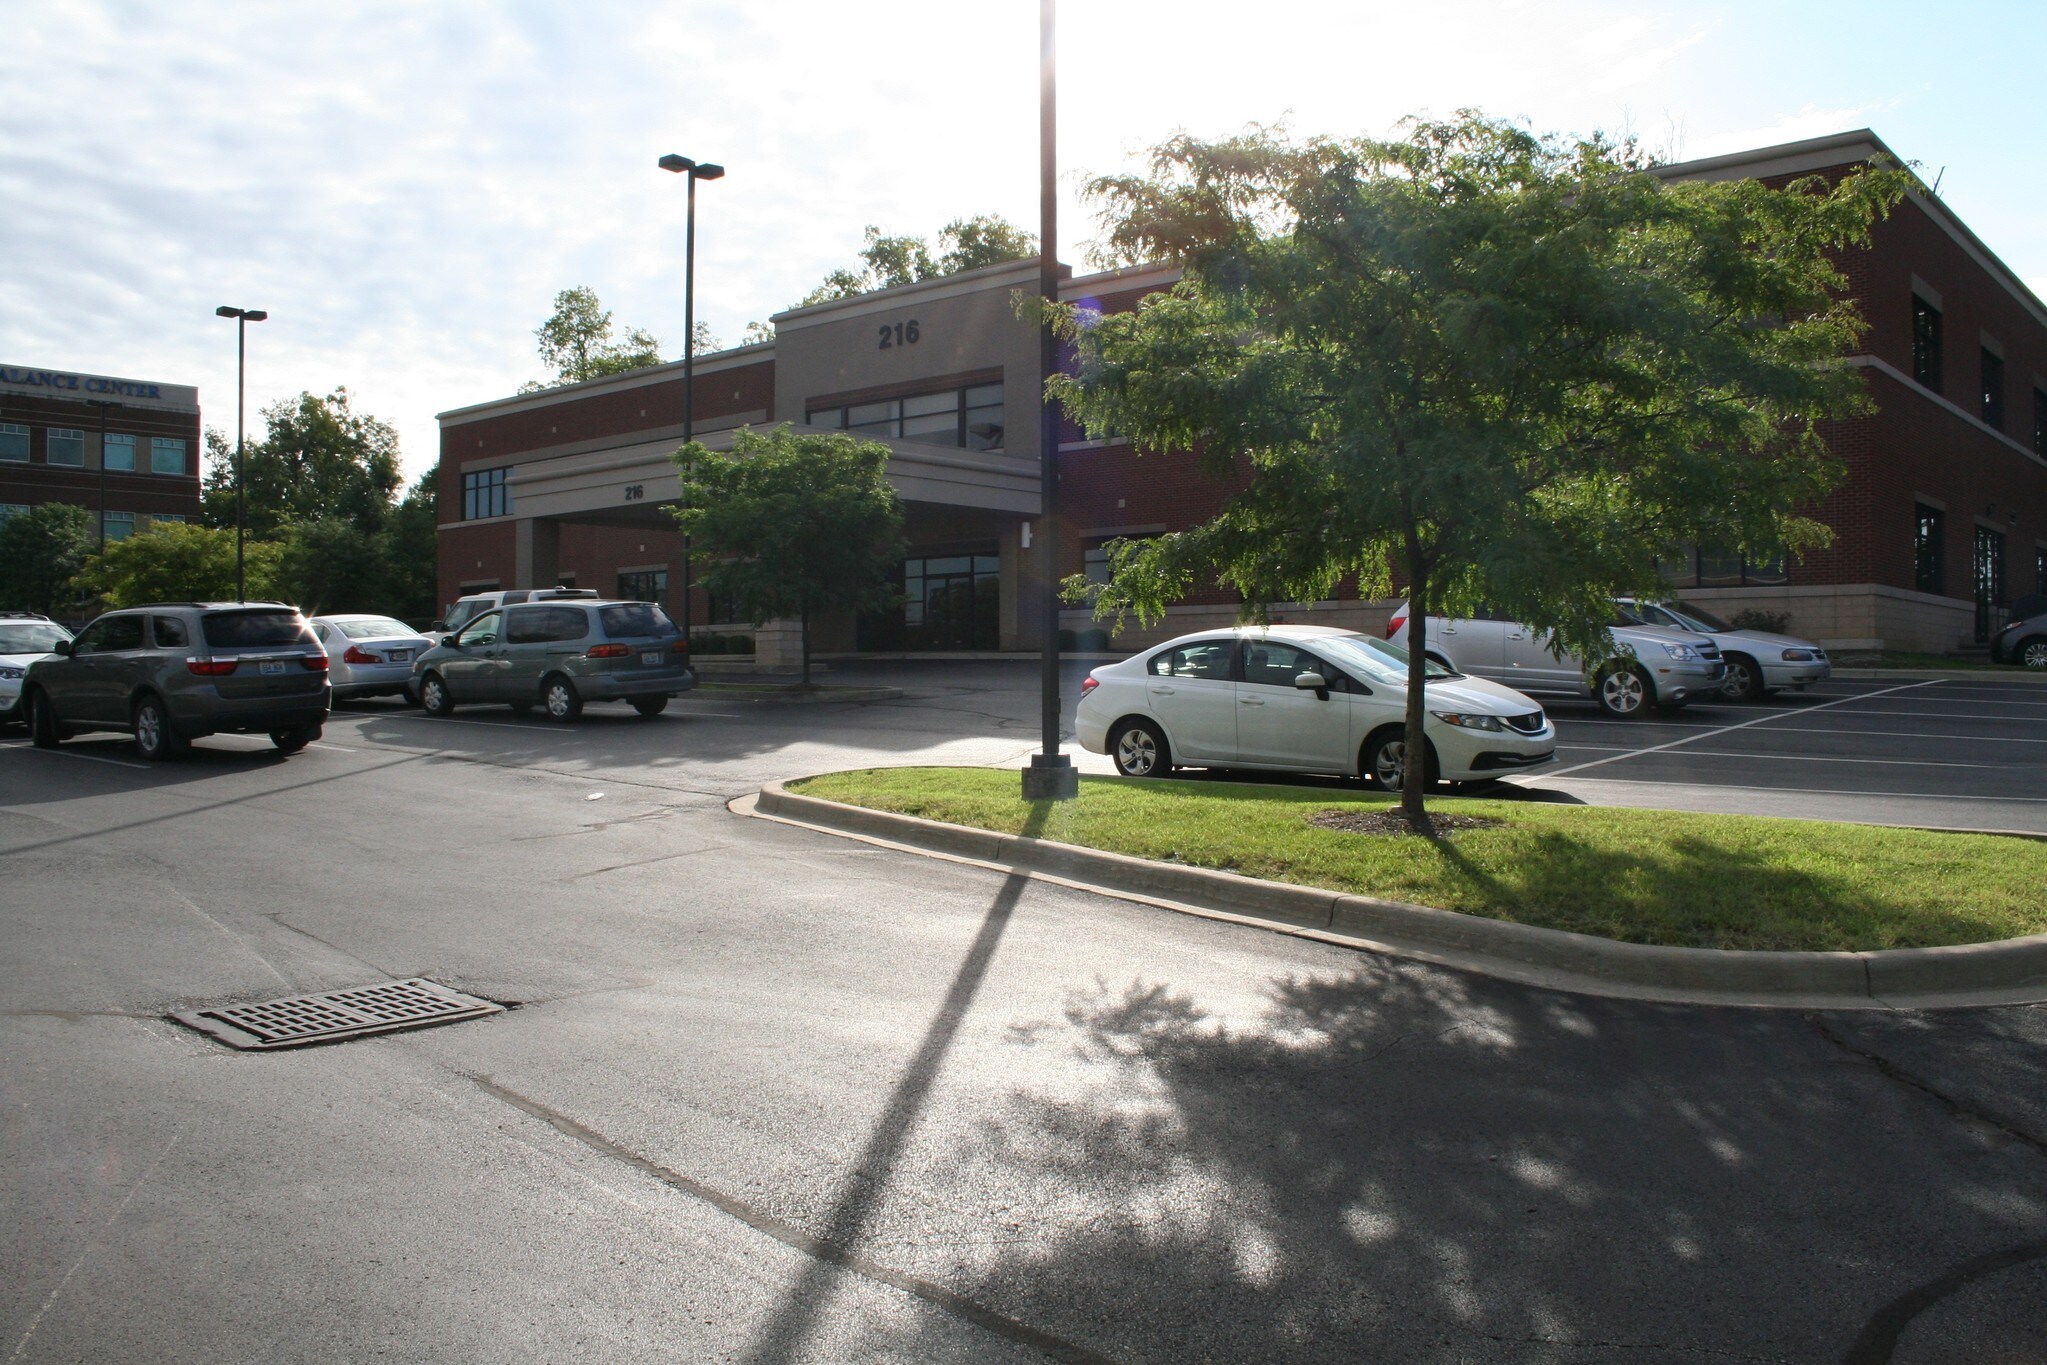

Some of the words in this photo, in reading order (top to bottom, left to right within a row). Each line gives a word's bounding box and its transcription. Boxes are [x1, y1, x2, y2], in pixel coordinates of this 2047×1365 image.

[878, 319, 920, 350] 216
[86, 378, 161, 399] CENTER
[625, 484, 644, 501] 216
